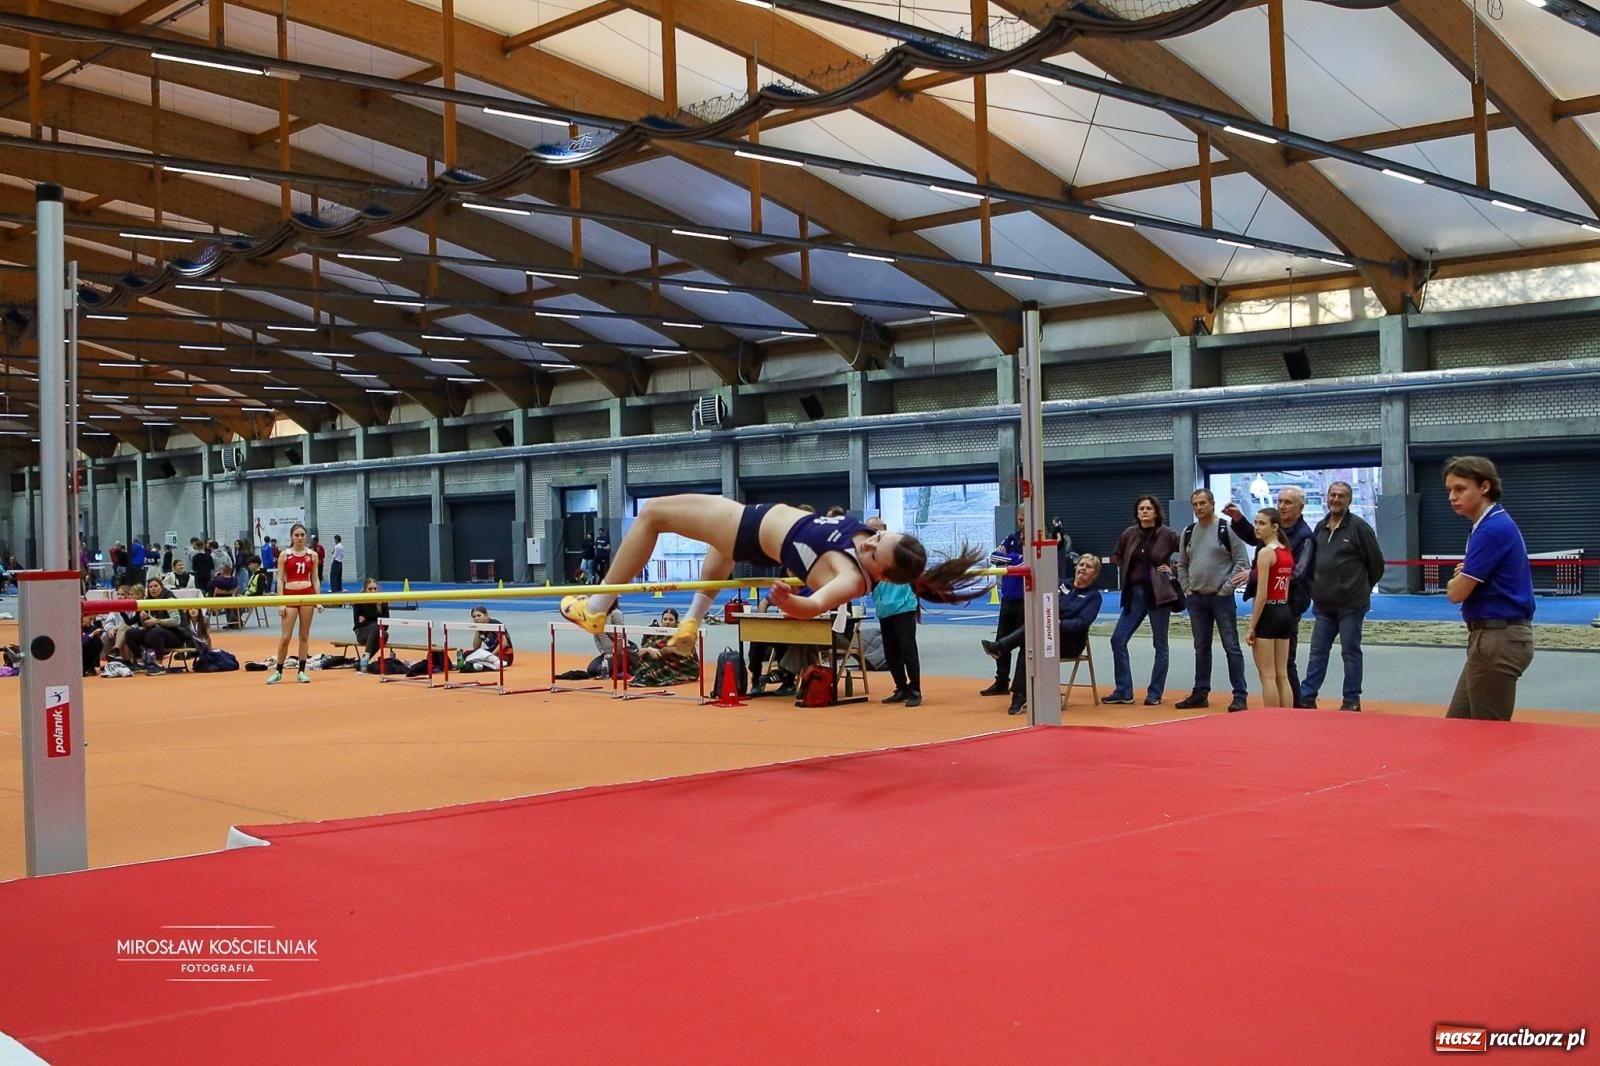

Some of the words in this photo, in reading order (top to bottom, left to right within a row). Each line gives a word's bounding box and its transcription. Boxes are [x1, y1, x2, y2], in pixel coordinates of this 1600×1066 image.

[295, 562, 306, 574] 71
[1045, 607, 1053, 641] polanik
[52, 709, 66, 754] polanik
